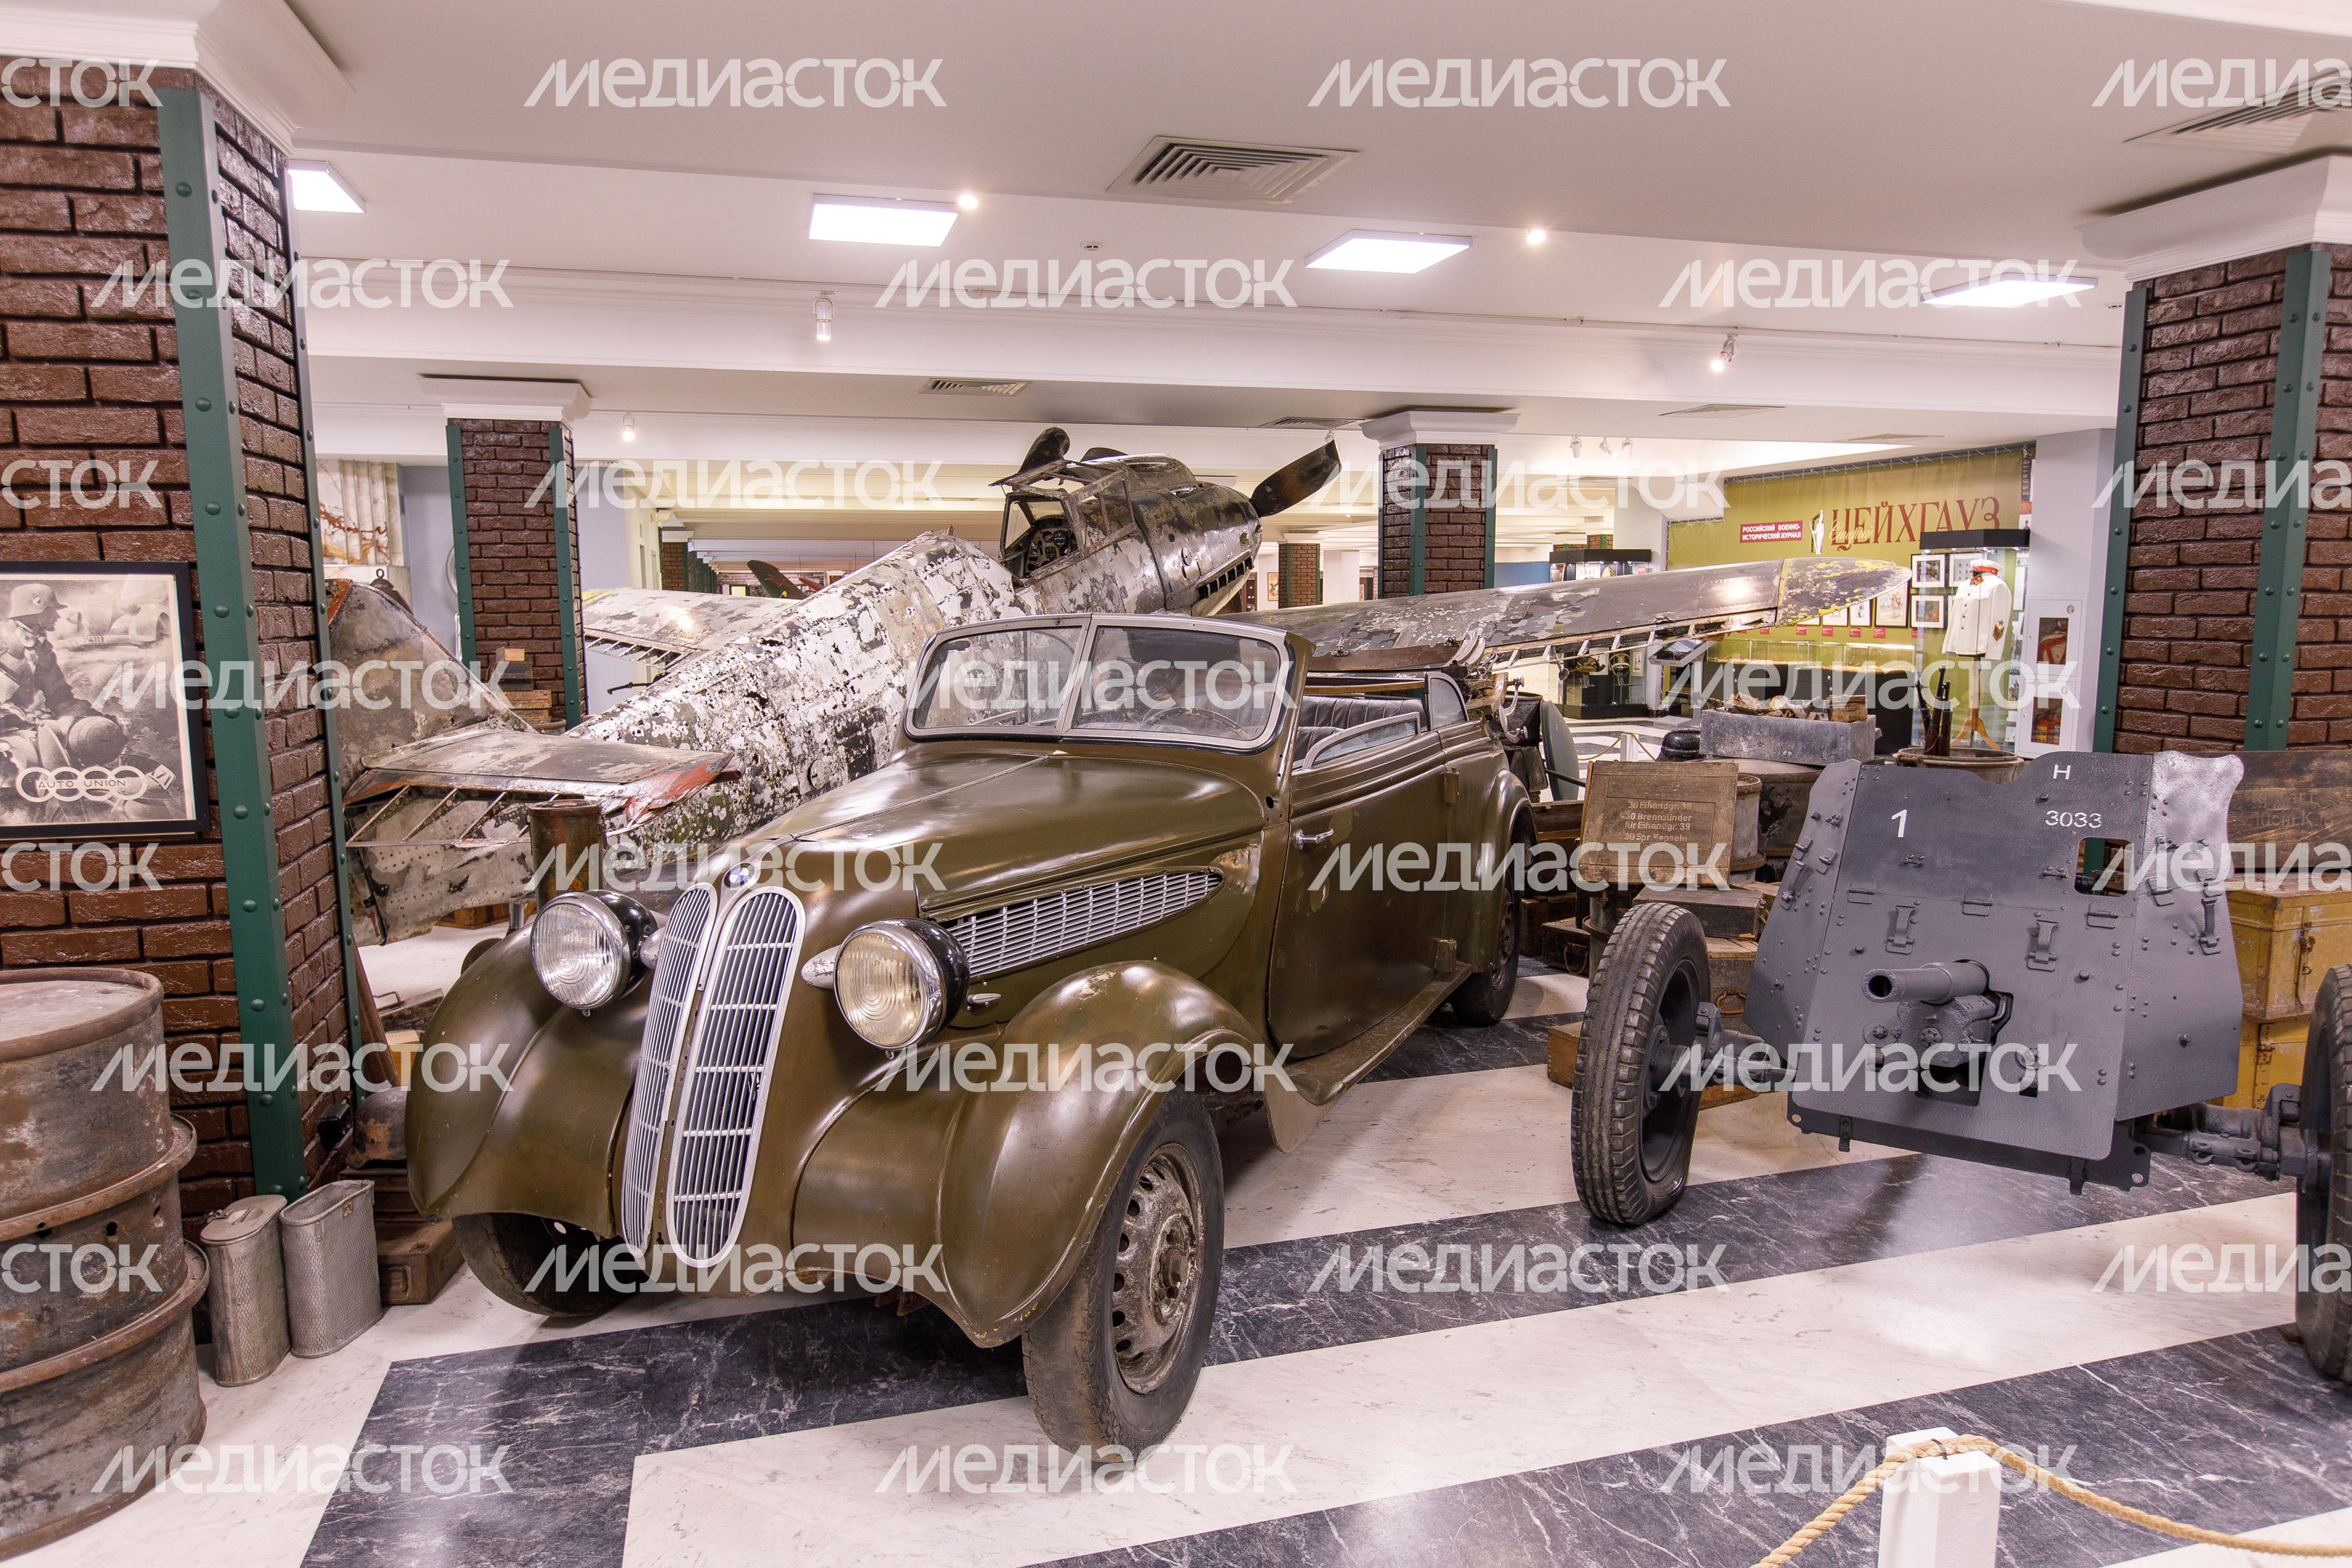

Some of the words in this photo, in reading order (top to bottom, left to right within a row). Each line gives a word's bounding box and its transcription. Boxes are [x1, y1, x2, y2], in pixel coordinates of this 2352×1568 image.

[1742, 523, 1775, 532] РОССИЙСКИЙ
[1831, 496, 2000, 552] ЦЕЙХГАУЗ
[1742, 531, 1780, 540] ИСТОРИЧЕСКИЙ
[2053, 764, 2071, 780] H
[1637, 813, 1693, 822] Brennzünder
[1891, 809, 1907, 838] 1
[2045, 810, 2102, 829] 3033
[1638, 821, 1677, 832] Eihandgr.
